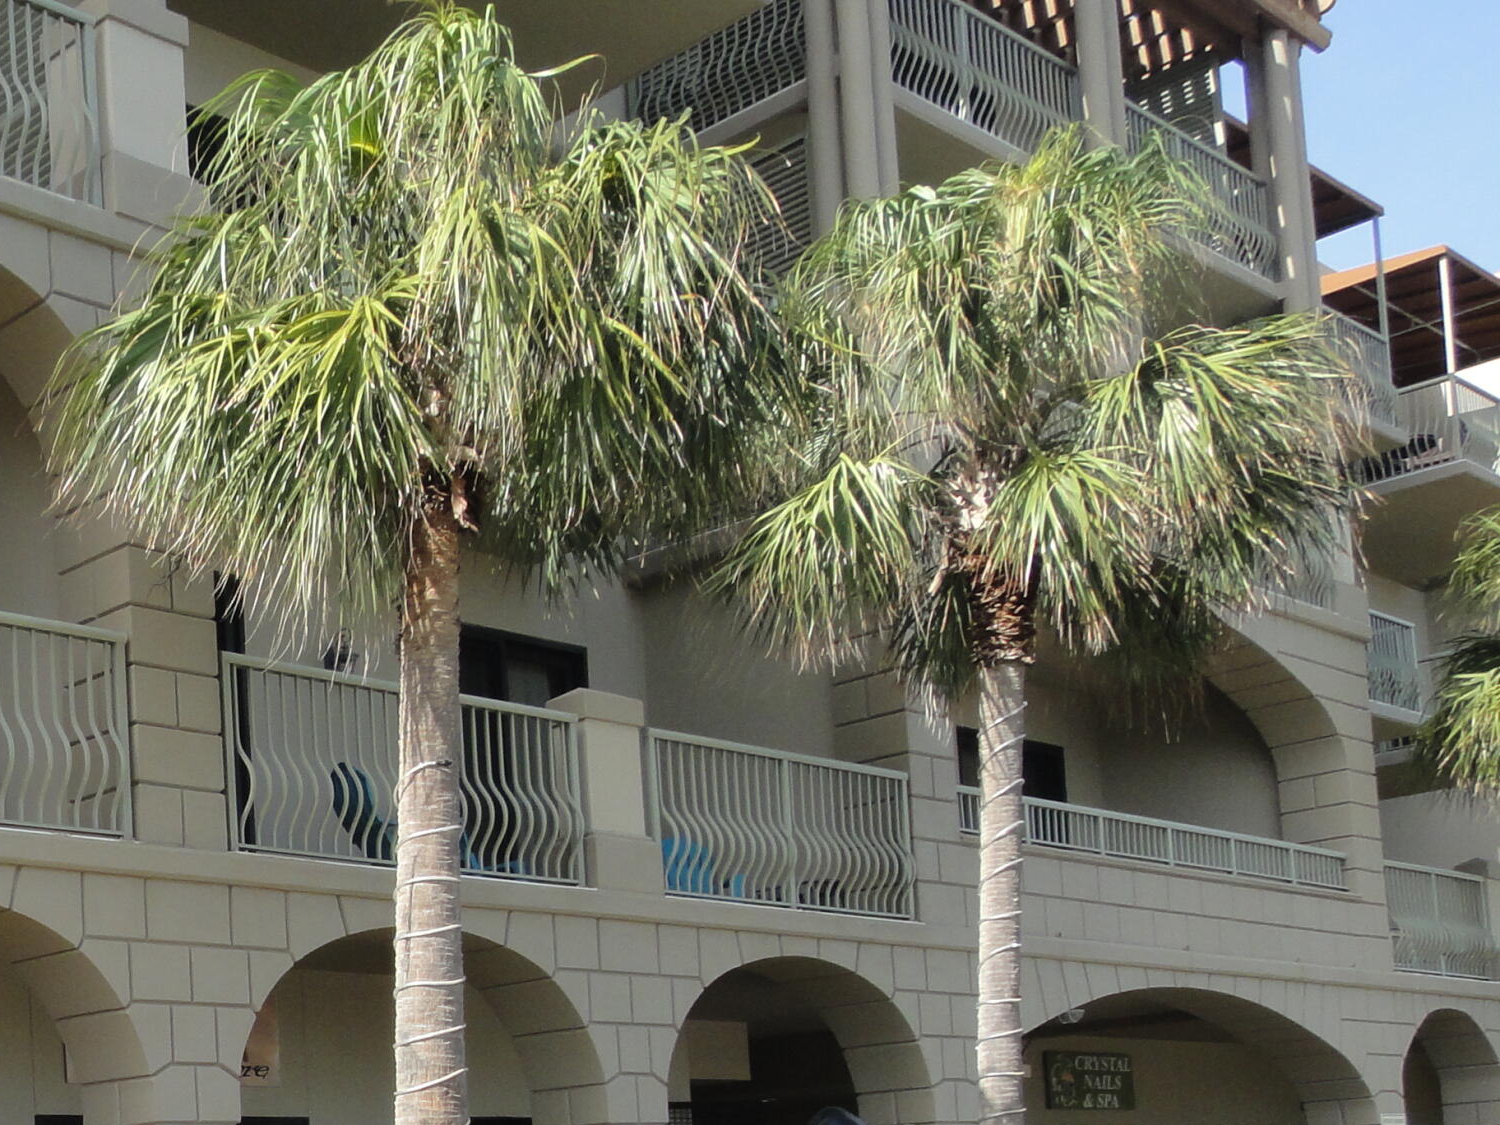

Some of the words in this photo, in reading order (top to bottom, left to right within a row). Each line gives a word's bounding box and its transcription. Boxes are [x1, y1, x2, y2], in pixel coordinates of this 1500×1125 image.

[1074, 1055, 1132, 1072] CRYSTAL
[1083, 1074, 1122, 1090] NAILS
[1083, 1092, 1094, 1108] &
[1096, 1093, 1120, 1109] SPA
